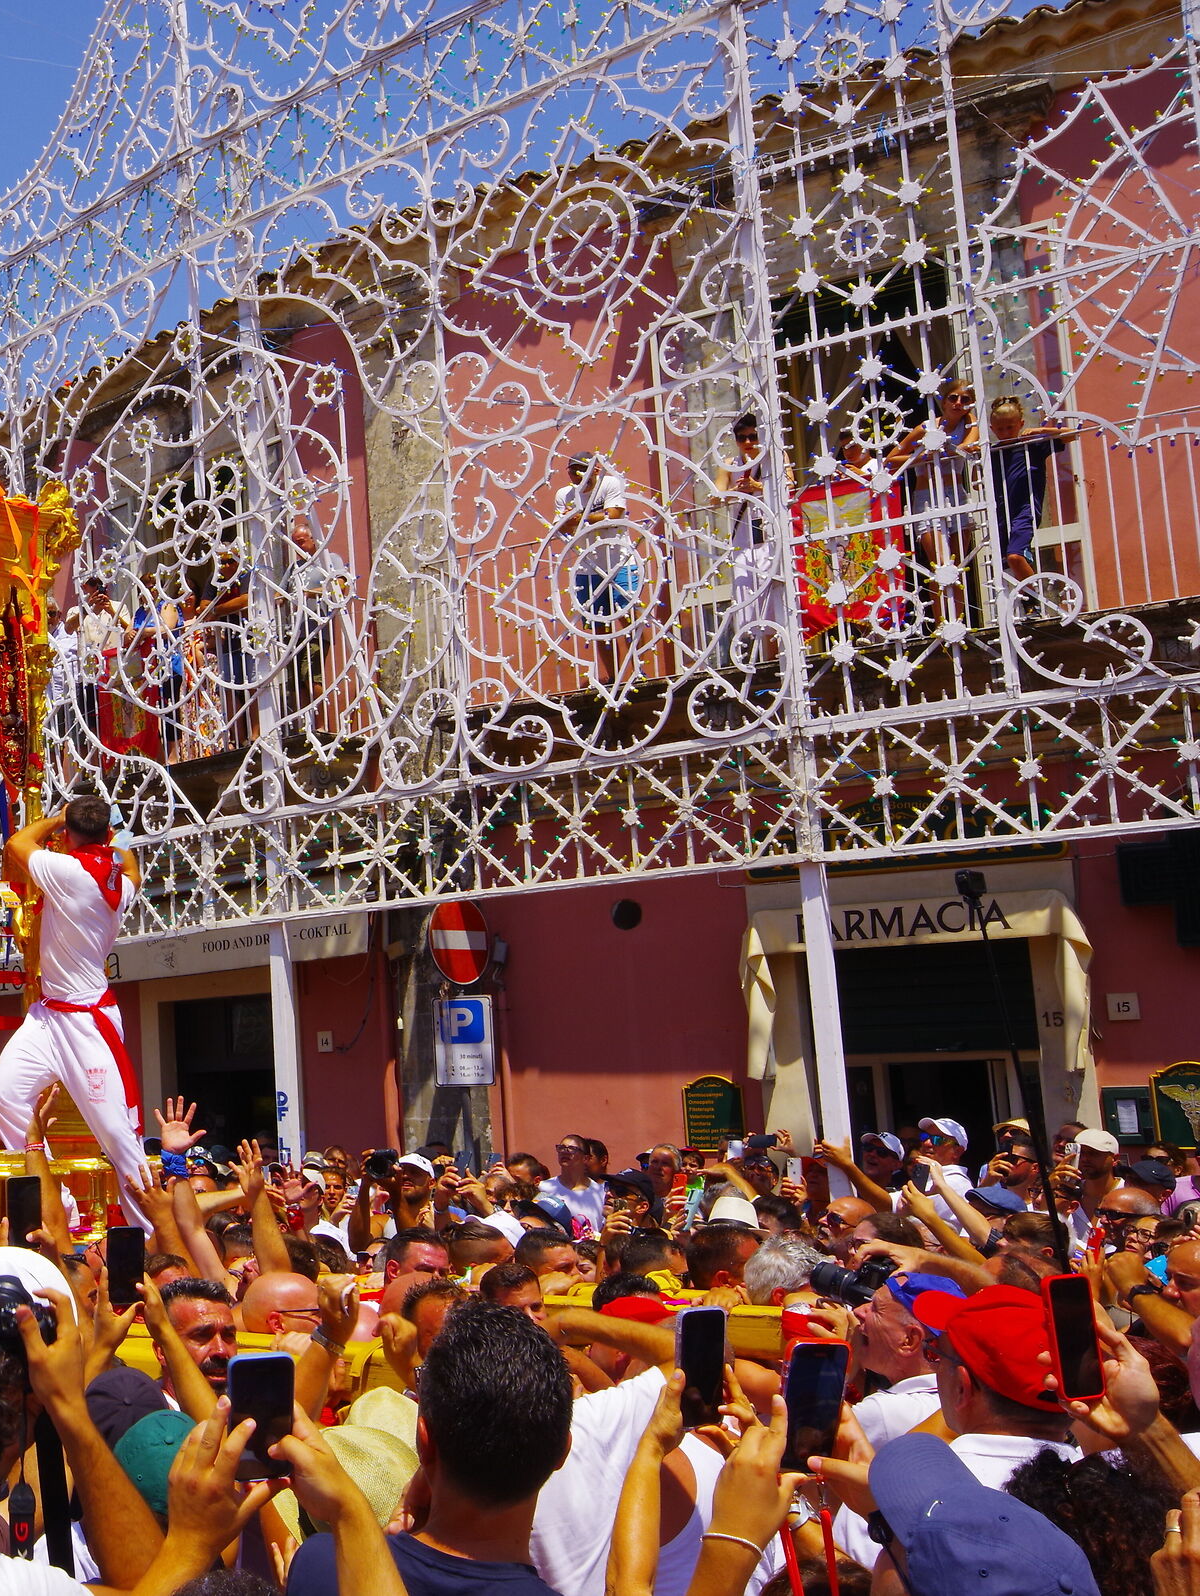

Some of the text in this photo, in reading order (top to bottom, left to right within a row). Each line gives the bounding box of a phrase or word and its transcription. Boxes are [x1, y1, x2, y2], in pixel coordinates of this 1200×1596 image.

[202, 939, 230, 953] FOOD
[232, 936, 253, 949] AND
[299, 923, 352, 941] COKTAIL
[1116, 1001, 1131, 1013] 15
[450, 1007, 474, 1037] P
[1041, 1011, 1065, 1028] 15
[321, 1038, 329, 1047] 14
